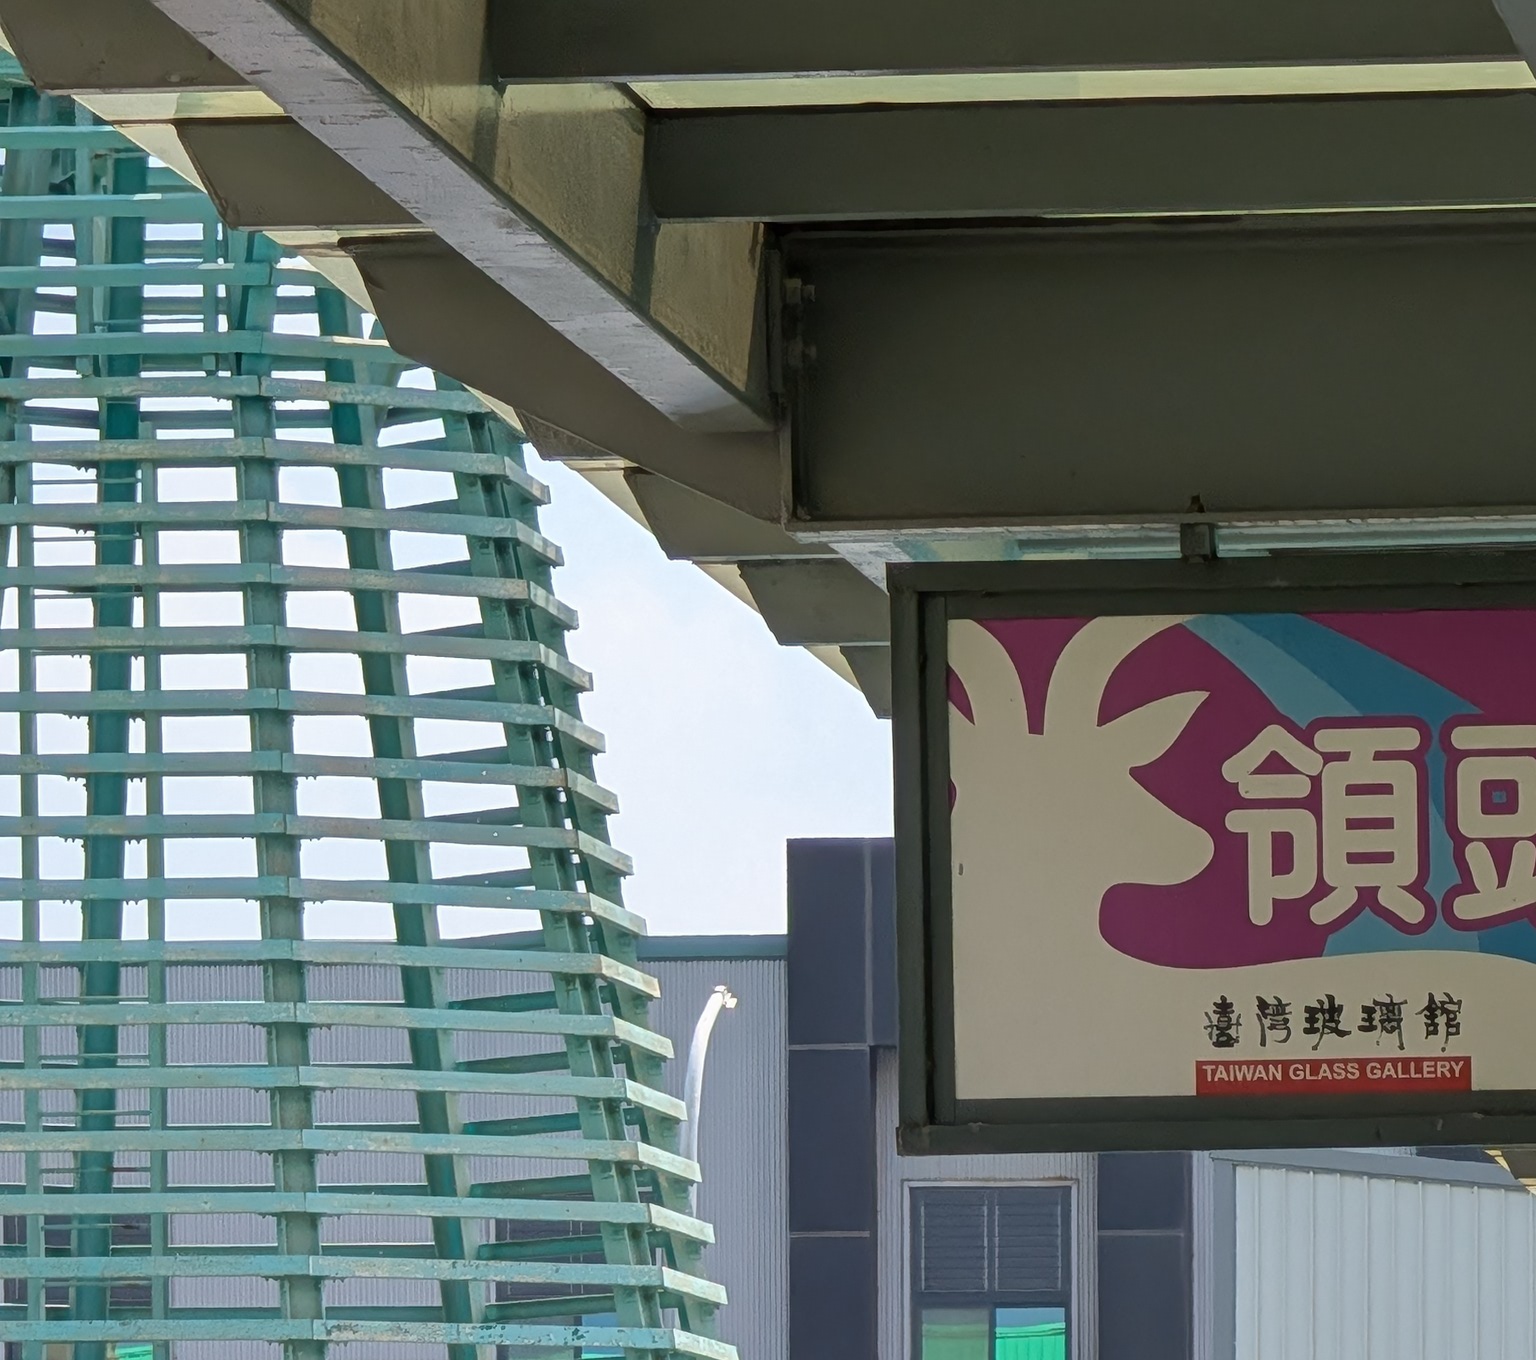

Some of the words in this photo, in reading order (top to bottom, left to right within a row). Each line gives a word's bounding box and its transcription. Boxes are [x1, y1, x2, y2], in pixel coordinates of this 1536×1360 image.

[1202, 1064, 1282, 1082] TAIWAN
[1289, 1062, 1360, 1080] GLASS
[1366, 1060, 1464, 1080] GALLERY
